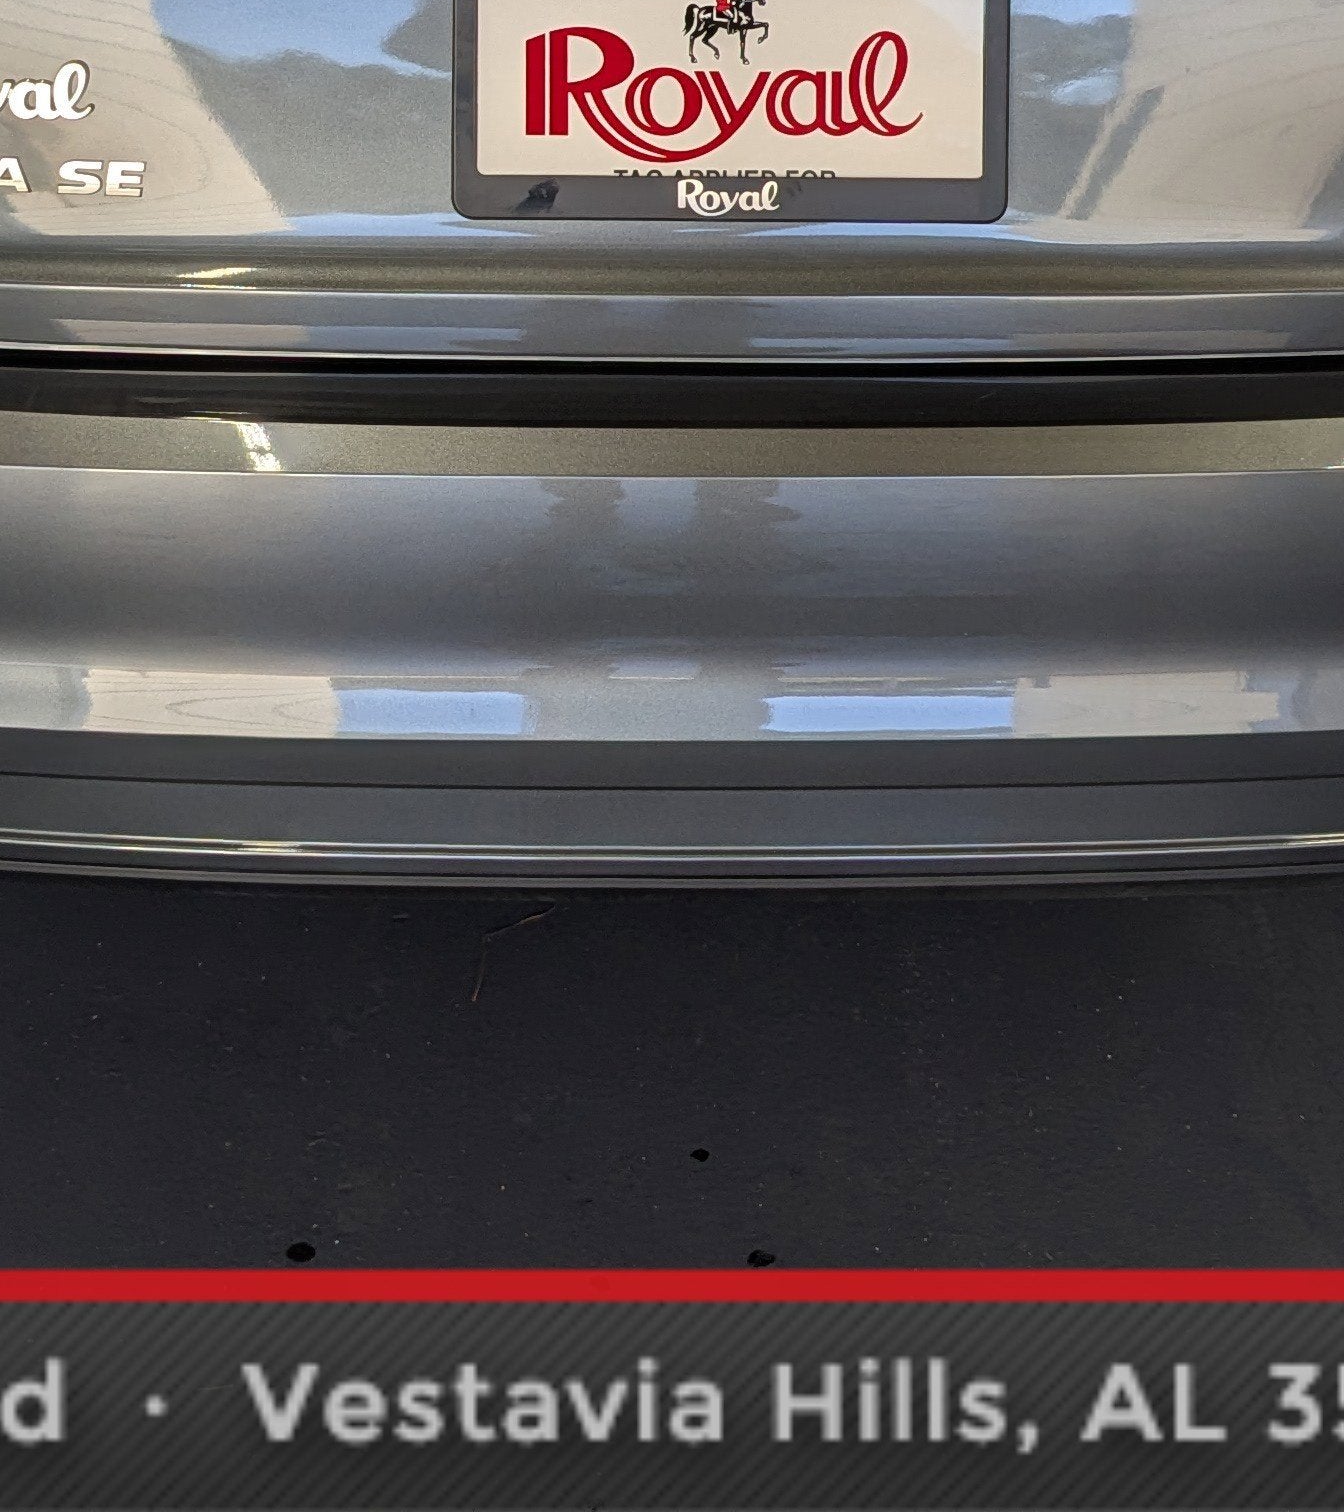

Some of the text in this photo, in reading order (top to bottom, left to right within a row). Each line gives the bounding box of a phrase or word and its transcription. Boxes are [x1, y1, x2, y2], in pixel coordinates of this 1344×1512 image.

[526, 26, 924, 163] Royal
[57, 159, 147, 197] SE
[677, 178, 781, 217] Royal
